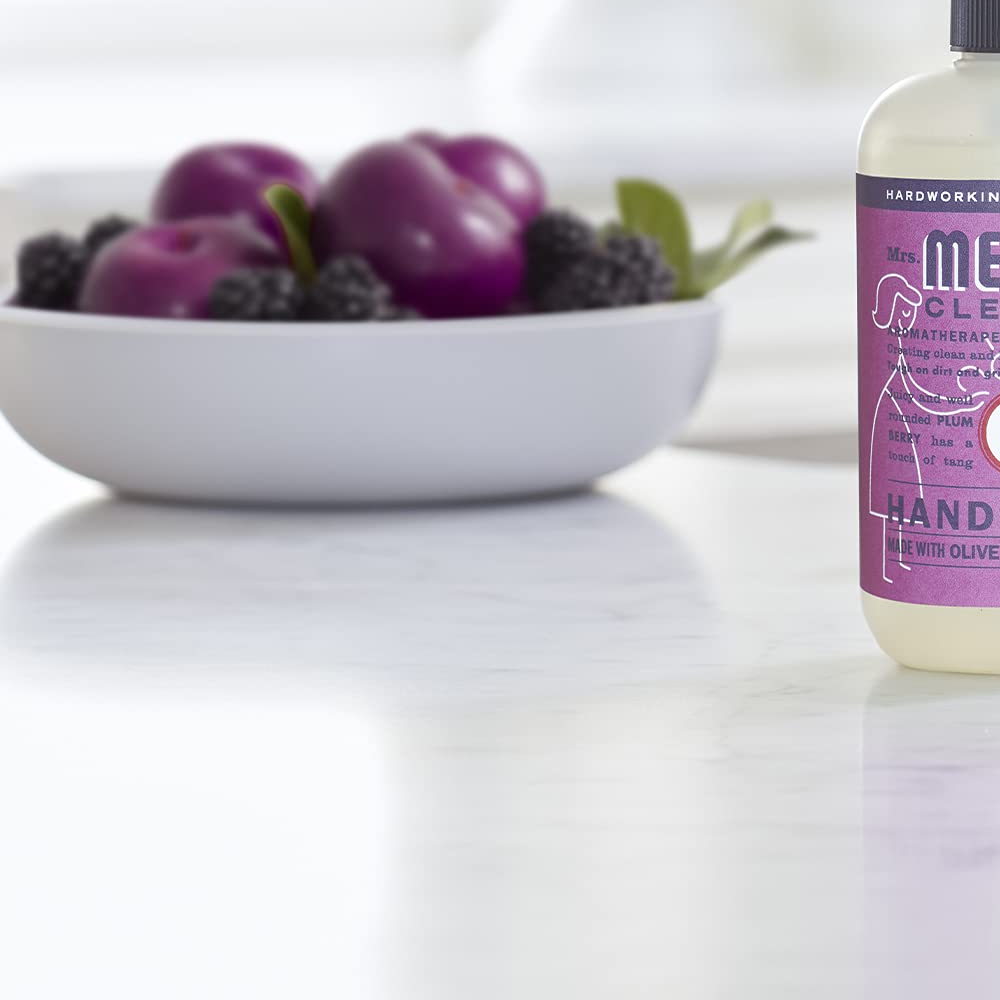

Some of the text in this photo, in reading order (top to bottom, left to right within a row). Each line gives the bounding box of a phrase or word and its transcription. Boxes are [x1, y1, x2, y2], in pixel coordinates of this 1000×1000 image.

[887, 246, 920, 264] Mrs.
[887, 343, 930, 360] Creating
[933, 349, 966, 360] clean
[969, 350, 994, 361] and
[915, 366, 929, 375] on
[932, 365, 953, 377] dirt
[957, 366, 979, 377] and
[919, 392, 941, 404] and
[946, 394, 974, 406] well
[888, 411, 974, 428] rounded PLUM
[888, 429, 974, 449] BERRY has a
[888, 450, 974, 471] touch of tang
[887, 493, 994, 531] HAND
[887, 536, 913, 555] MADE
[915, 541, 945, 558] WITH
[949, 543, 1000, 560] OLIVE
